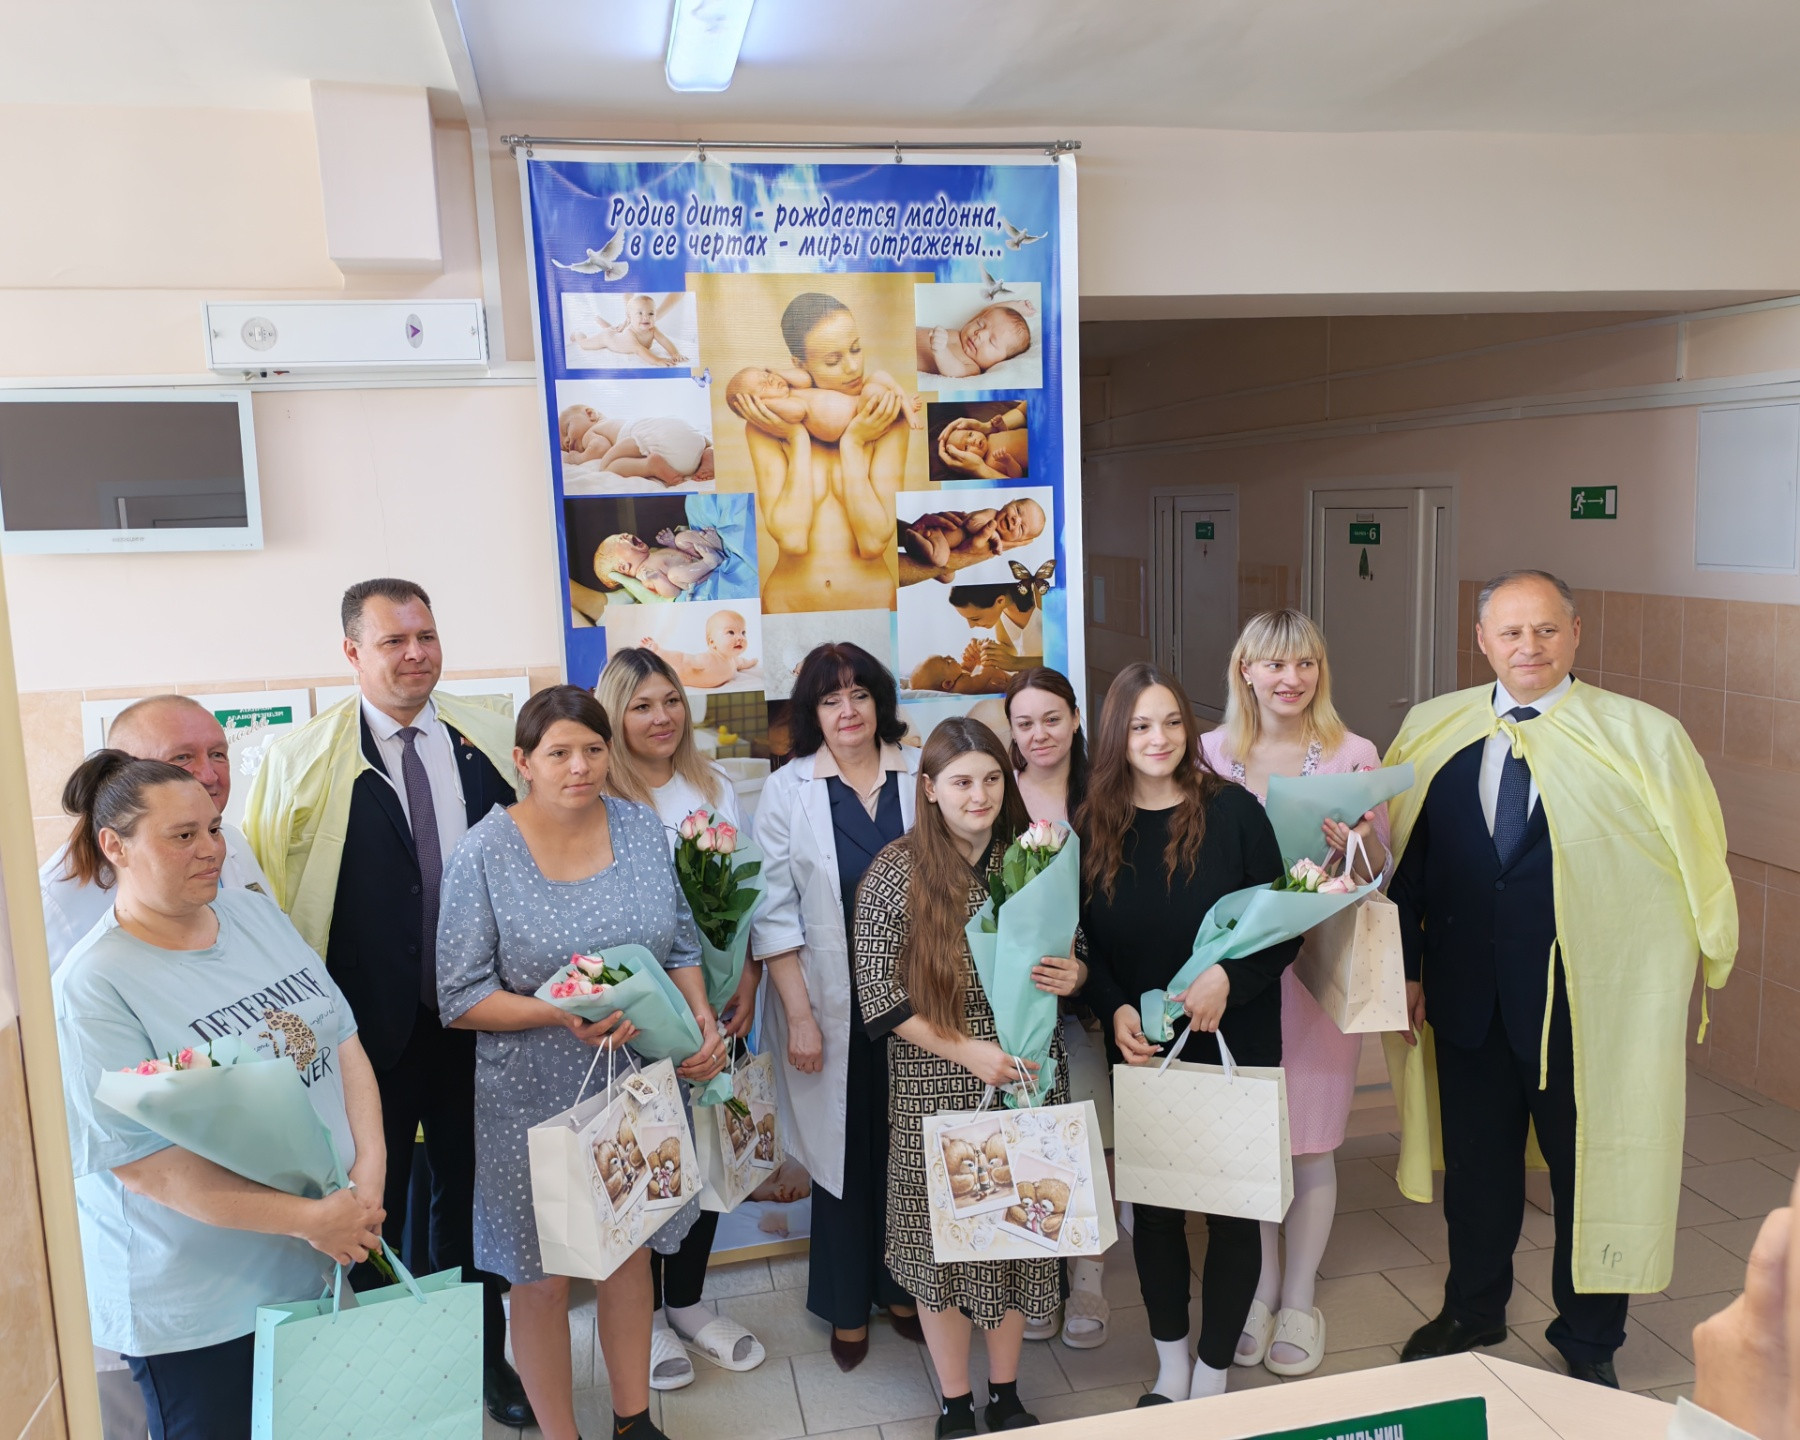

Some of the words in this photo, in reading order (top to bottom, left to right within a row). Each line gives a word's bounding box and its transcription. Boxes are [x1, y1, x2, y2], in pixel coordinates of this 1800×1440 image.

[610, 195, 676, 227] Родив
[686, 194, 743, 227] дитя
[774, 196, 896, 234] рождается
[904, 196, 1002, 231] мадонна,
[630, 235, 642, 256] в
[653, 233, 677, 256] ее
[688, 232, 769, 262] чертах
[798, 233, 861, 262] миры
[869, 233, 1002, 262] отражены...
[1369, 527, 1377, 541] 6
[188, 967, 329, 1042] DETERMINE
[300, 1046, 334, 1088] VER
